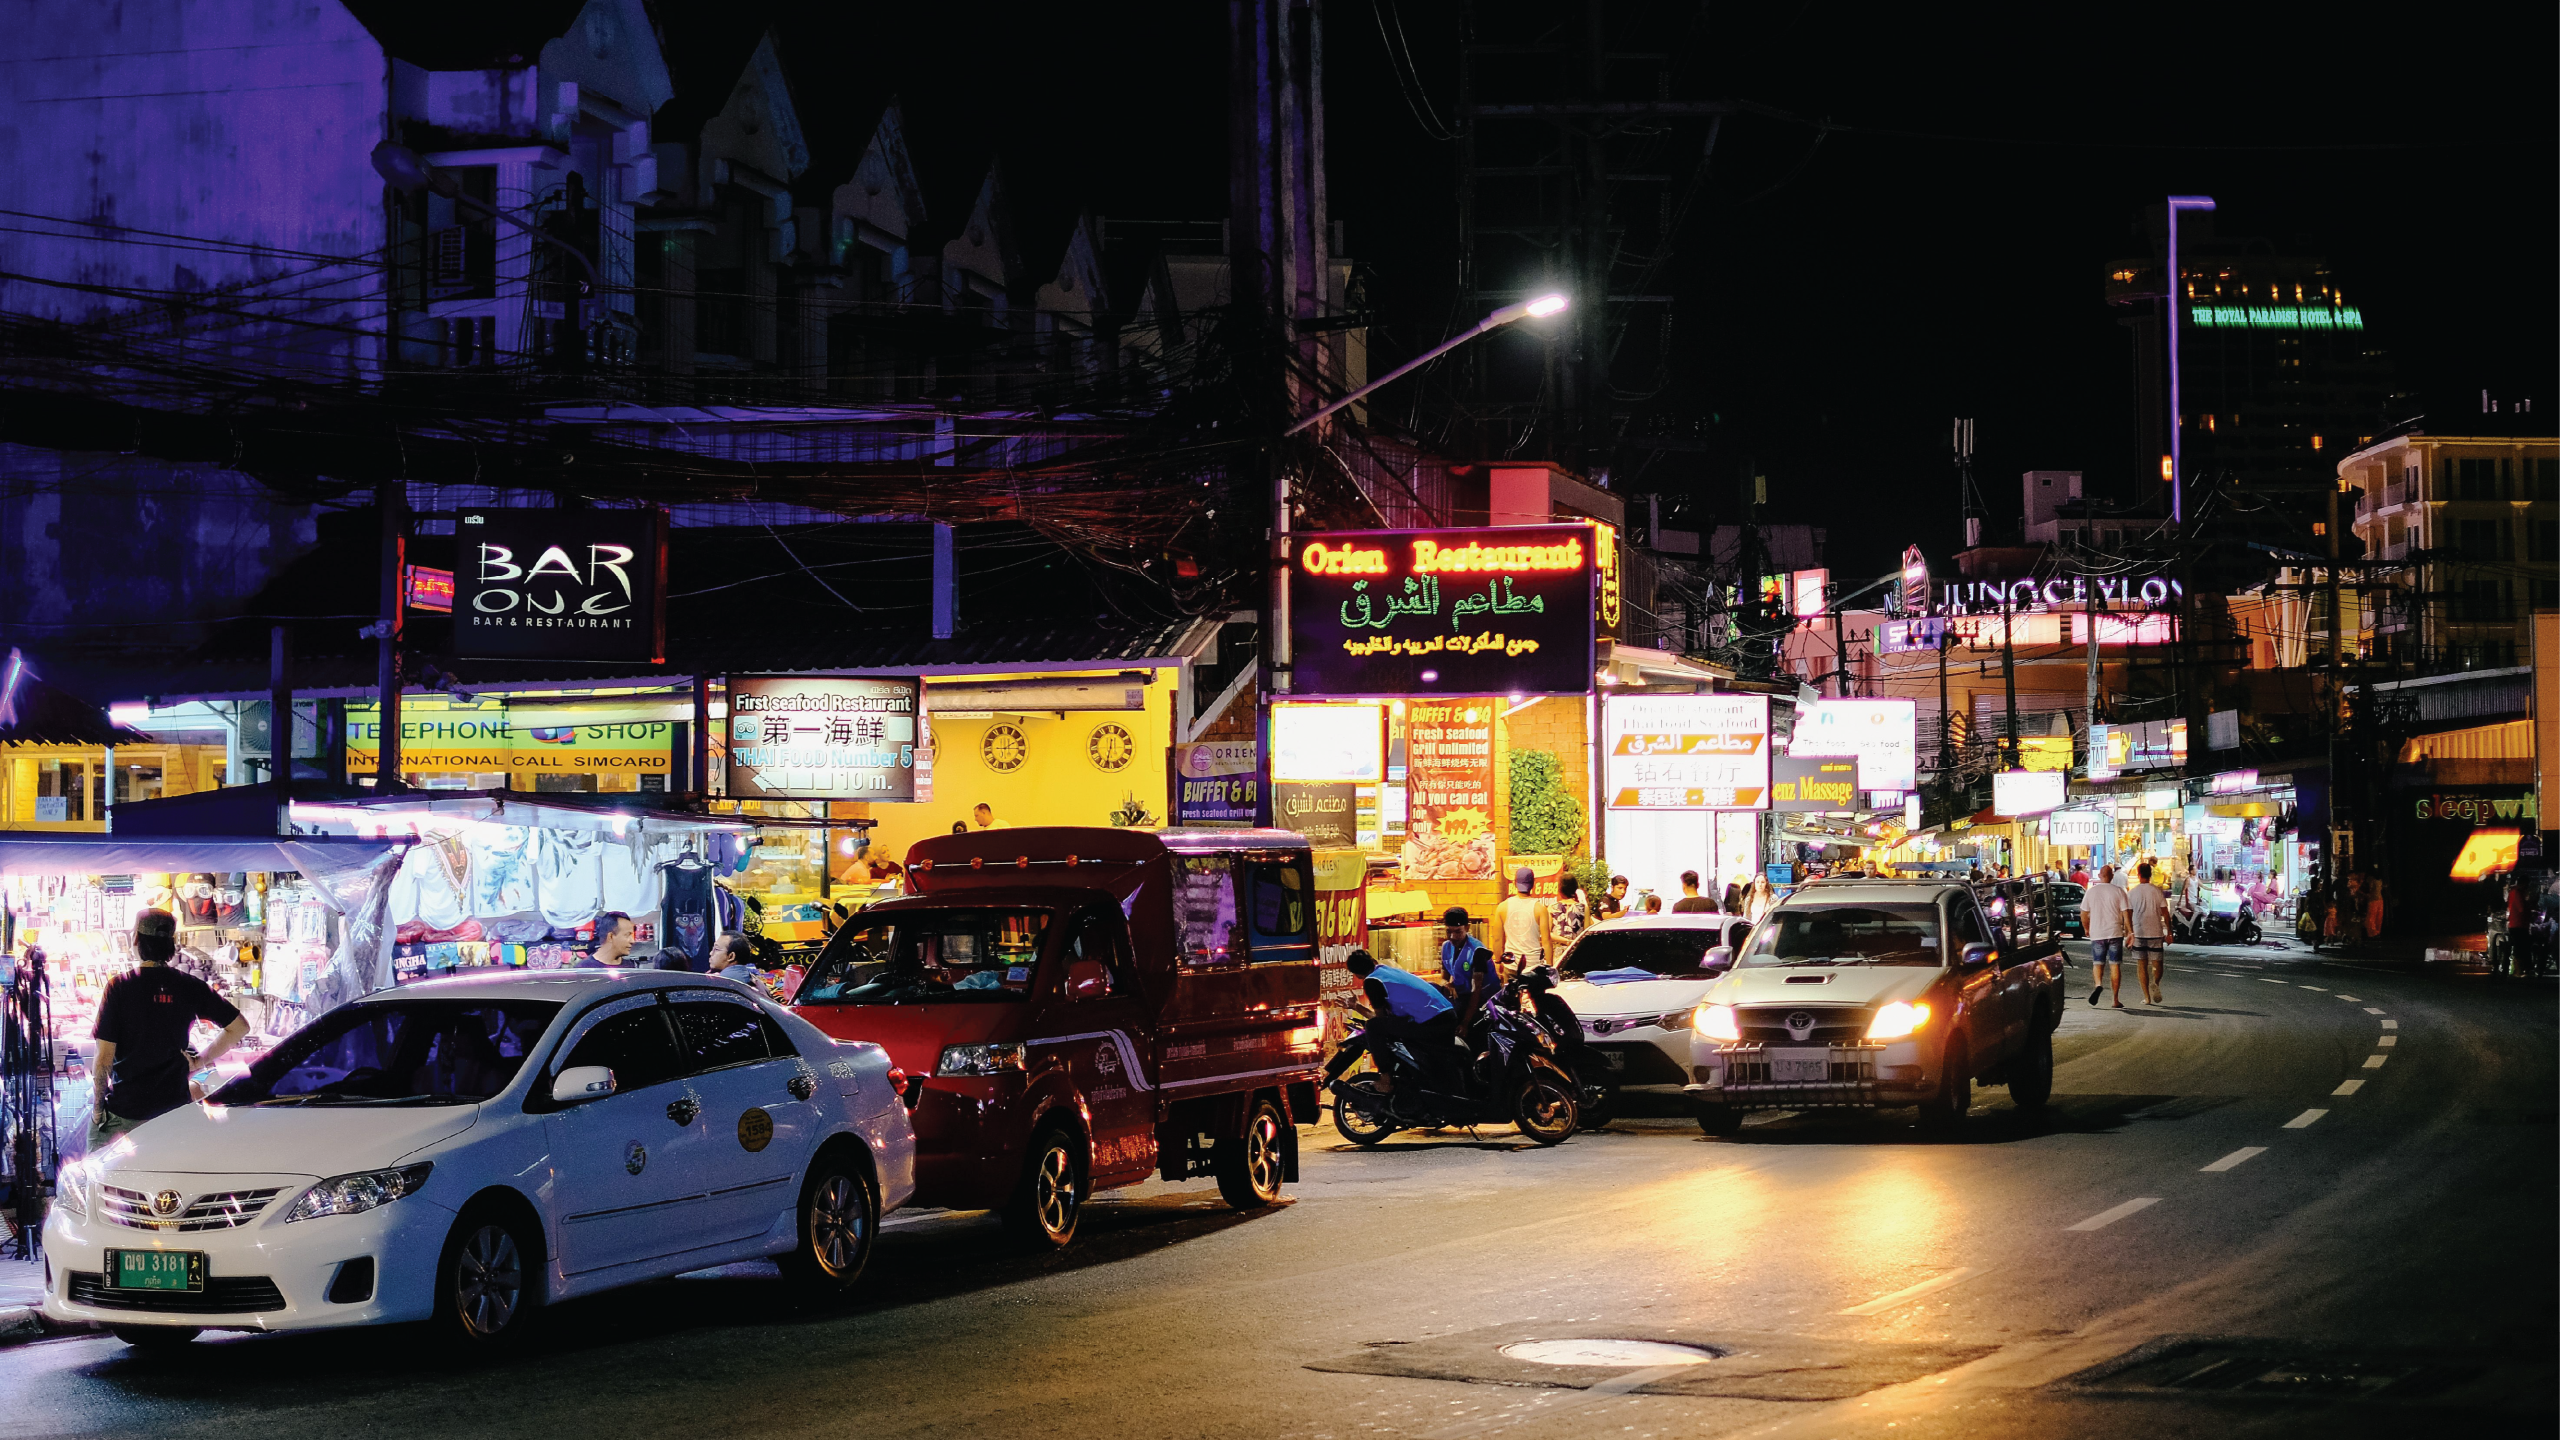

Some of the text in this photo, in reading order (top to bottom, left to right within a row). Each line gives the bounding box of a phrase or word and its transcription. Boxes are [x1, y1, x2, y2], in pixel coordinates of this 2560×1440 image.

[2192, 308, 2363, 325] THE ROYAL PARADISE HOTEL & SPA
[1302, 542, 1388, 574] Orien
[1412, 538, 1583, 574] Restaurant
[476, 541, 634, 602] BAR
[473, 588, 631, 615] ONE
[1340, 572, 1545, 633] مطاعم الشرق
[473, 617, 632, 628] BAR & RESTAURANT
[735, 693, 912, 712] First seafood Restaurant
[1411, 706, 1452, 723] BUFFET
[1453, 706, 1463, 723] &
[347, 722, 667, 740] TEEPHONE SHOP
[761, 714, 886, 746] 第一海鮮
[1412, 728, 1444, 740] Fresh
[1446, 727, 1489, 740] Seafood
[1412, 742, 1489, 755] Grill Unlimited
[1627, 733, 1753, 755] مطاعم الشرق
[512, 756, 564, 767] CALL
[573, 756, 666, 767] SIMCARD
[734, 744, 913, 768] THAI FOOD Number 5
[840, 771, 894, 790] 10 m.
[1183, 780, 1229, 803] BUFFET
[1231, 780, 1243, 803] &
[1412, 791, 1488, 807] All you can eat
[1799, 776, 1854, 806] Massage
[1182, 809, 1201, 818] Fresh
[1202, 808, 1228, 818] Seafood
[1286, 791, 1347, 818] مطاعم الشرق
[1412, 807, 1427, 820] for
[1412, 822, 1432, 834] only
[2053, 821, 2099, 835] TATTOO
[1523, 859, 1558, 867] ORIENT
[1534, 882, 1542, 895] &
[746, 1122, 772, 1137] 1584
[152, 1254, 186, 1272] 3181
